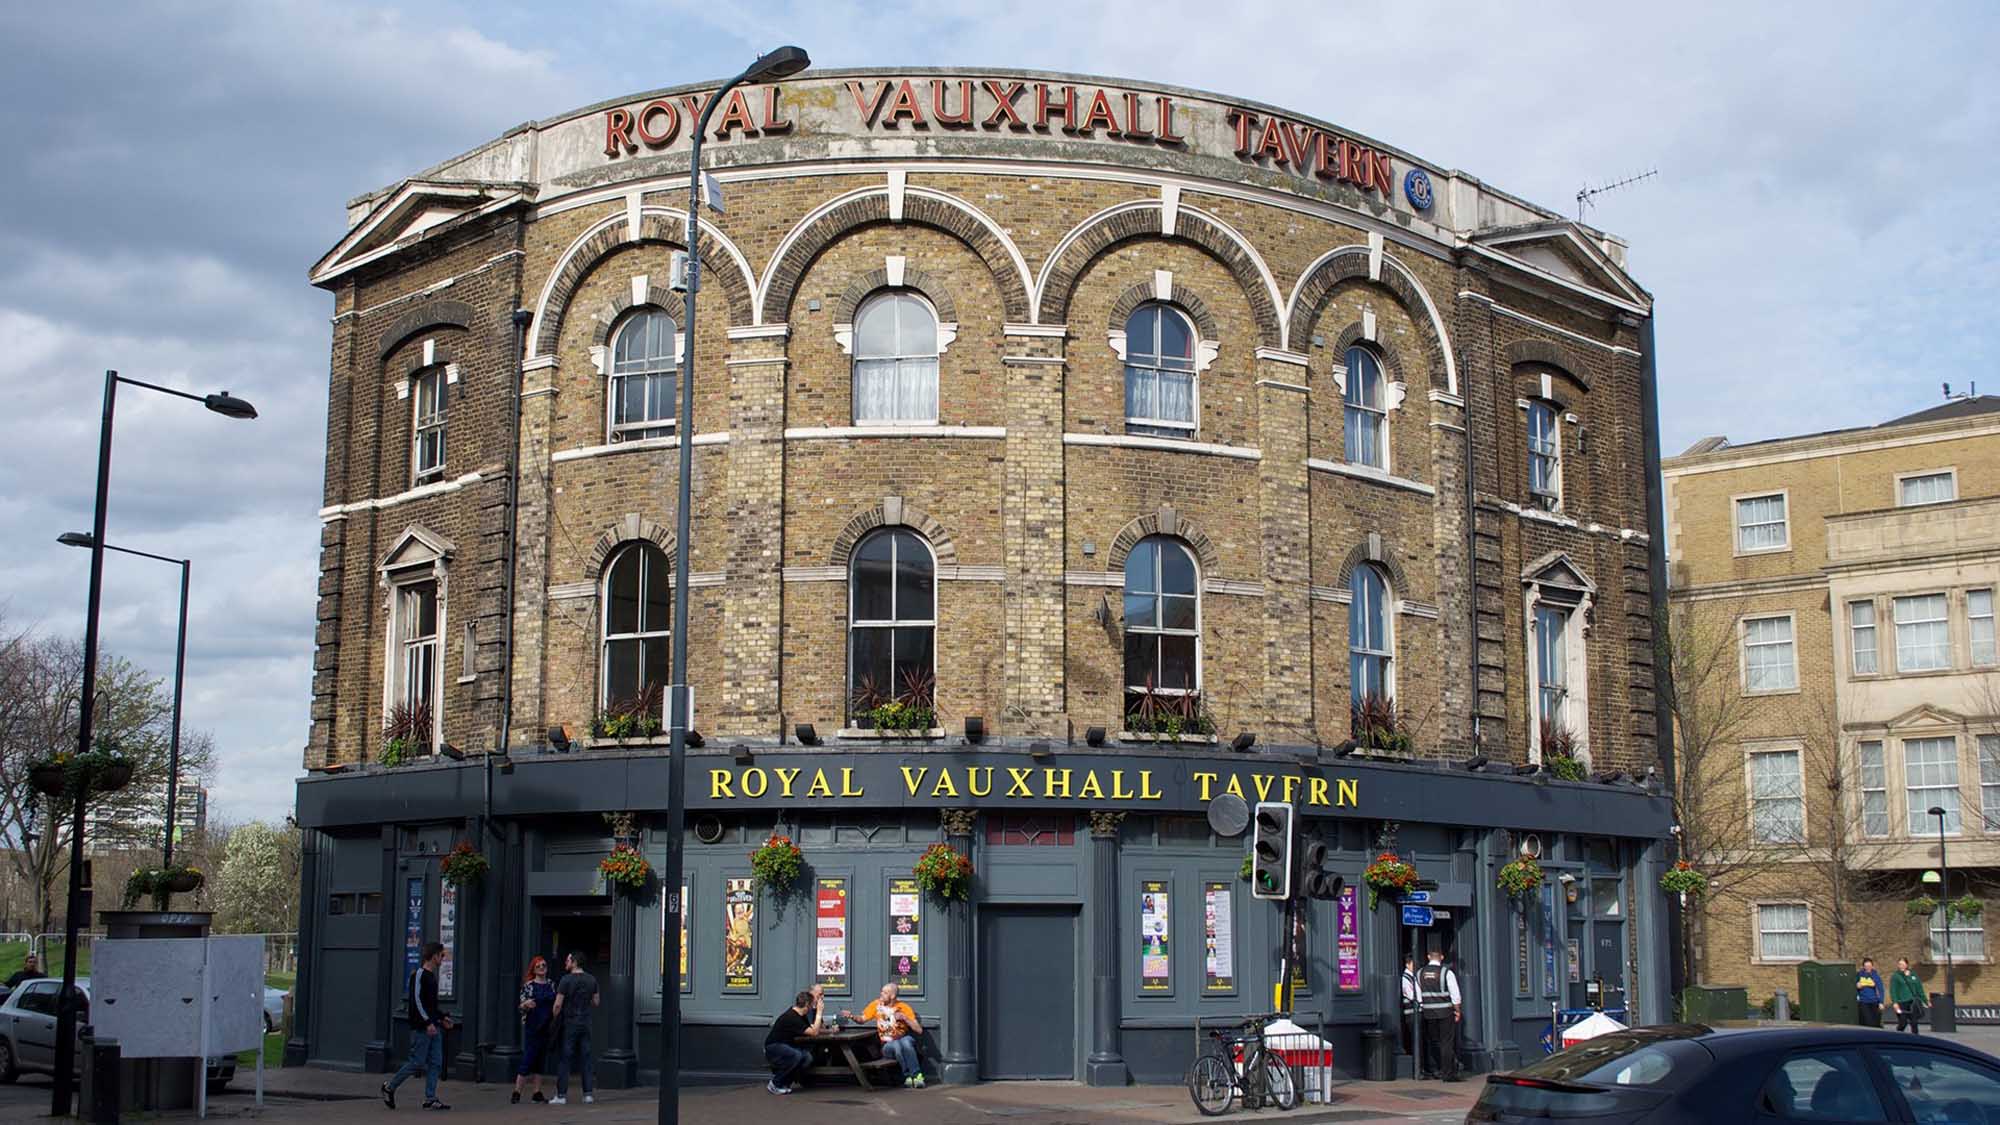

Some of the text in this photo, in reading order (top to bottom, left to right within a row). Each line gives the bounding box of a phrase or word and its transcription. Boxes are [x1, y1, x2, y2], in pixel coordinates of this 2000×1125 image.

[603, 87, 792, 158] ROYAL
[846, 80, 1185, 143] VAUXHALL
[1227, 107, 1392, 196] TAVERN
[709, 767, 1360, 807] ROYAL VAUXHALL TAVERN
[671, 894, 678, 912] 67
[1954, 1007, 2000, 1019] UXHAL
